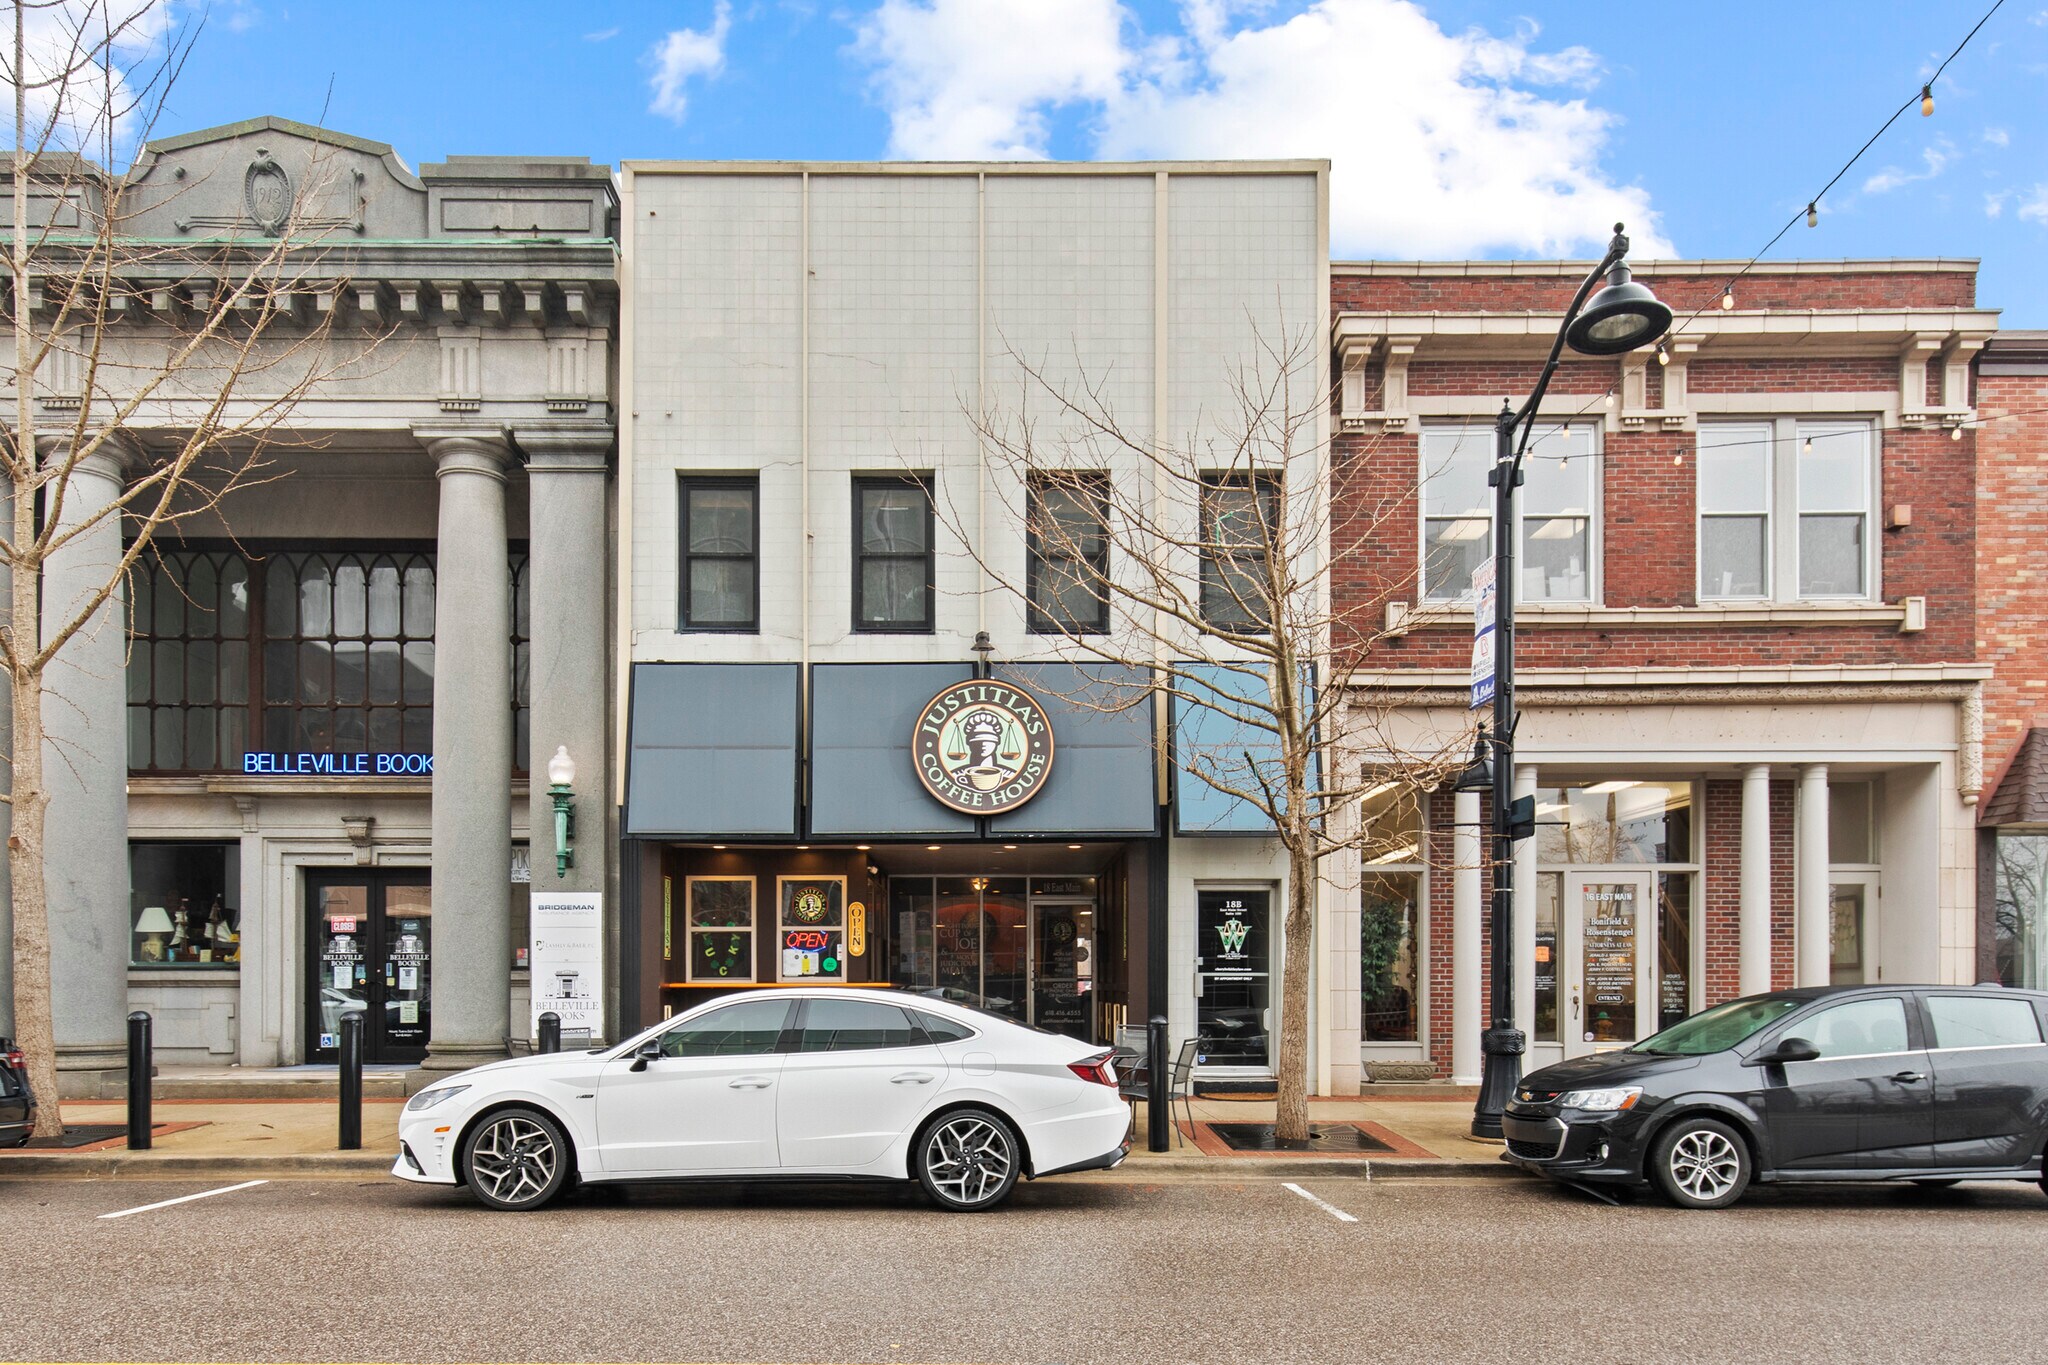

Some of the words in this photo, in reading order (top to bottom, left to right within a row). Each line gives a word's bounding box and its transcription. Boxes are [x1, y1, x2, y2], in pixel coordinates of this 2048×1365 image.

[922, 686, 1044, 738] JUSTITIA'S
[244, 754, 369, 773] BELLEVILLE
[922, 753, 983, 806] COFFEE
[989, 753, 1046, 806] HOUSE
[1052, 882, 1064, 892] East
[1065, 882, 1080, 892] Main
[334, 922, 355, 930] CLOSED
[852, 908, 862, 946] OPEN
[1586, 928, 1633, 937] Rosenstengel
[940, 928, 961, 938] CUP
[786, 932, 828, 948] OPEN
[955, 938, 977, 951] JOE
[536, 1002, 598, 1010] BELLEVILLE
